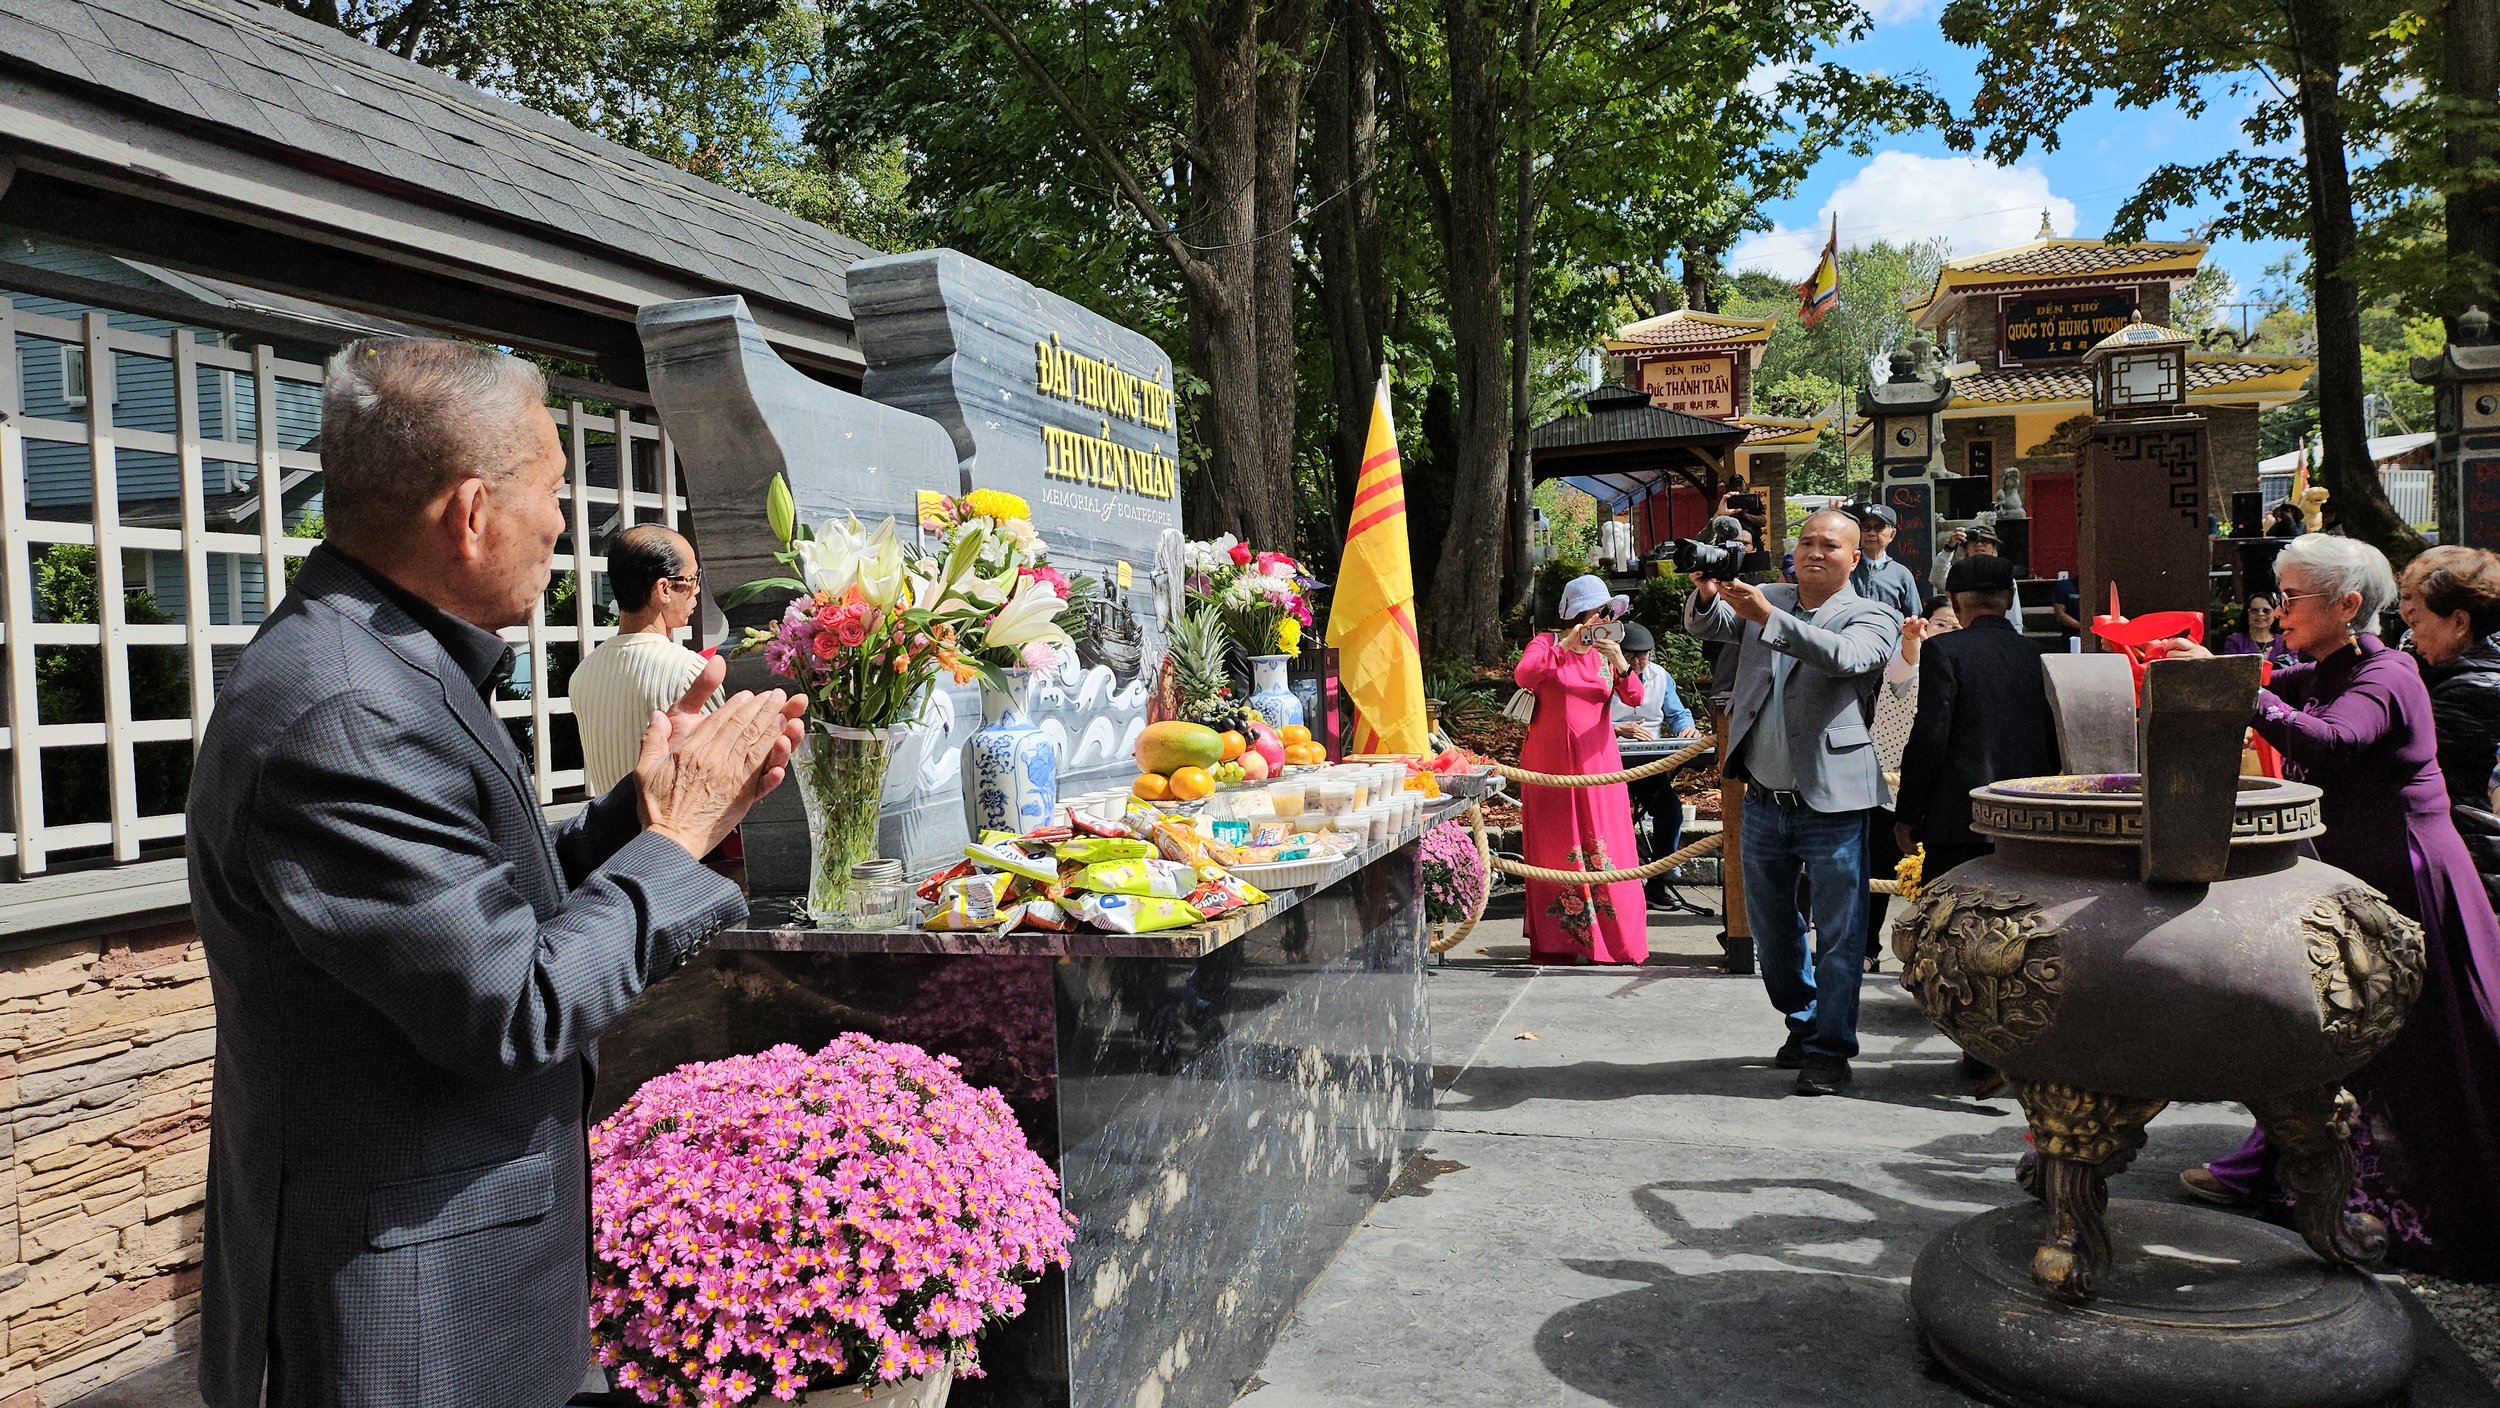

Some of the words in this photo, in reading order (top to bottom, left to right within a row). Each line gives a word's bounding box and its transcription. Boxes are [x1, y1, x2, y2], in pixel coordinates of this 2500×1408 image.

[2007, 317, 2038, 342] QUỐC
[1035, 330, 1073, 399] ĐÀI
[1073, 356, 1140, 420] THƯƠNG
[1140, 364, 1173, 430] TIẾC
[1665, 377, 1701, 397] THÁNH
[1702, 374, 1729, 395] TRẦN
[1041, 418, 1126, 489] THUYỀN
[1126, 442, 1175, 500] NHÂN
[1042, 487, 1101, 513] MEMORIAL
[1101, 495, 1119, 521] of
[1118, 503, 1173, 526] BOATPEOPLE
